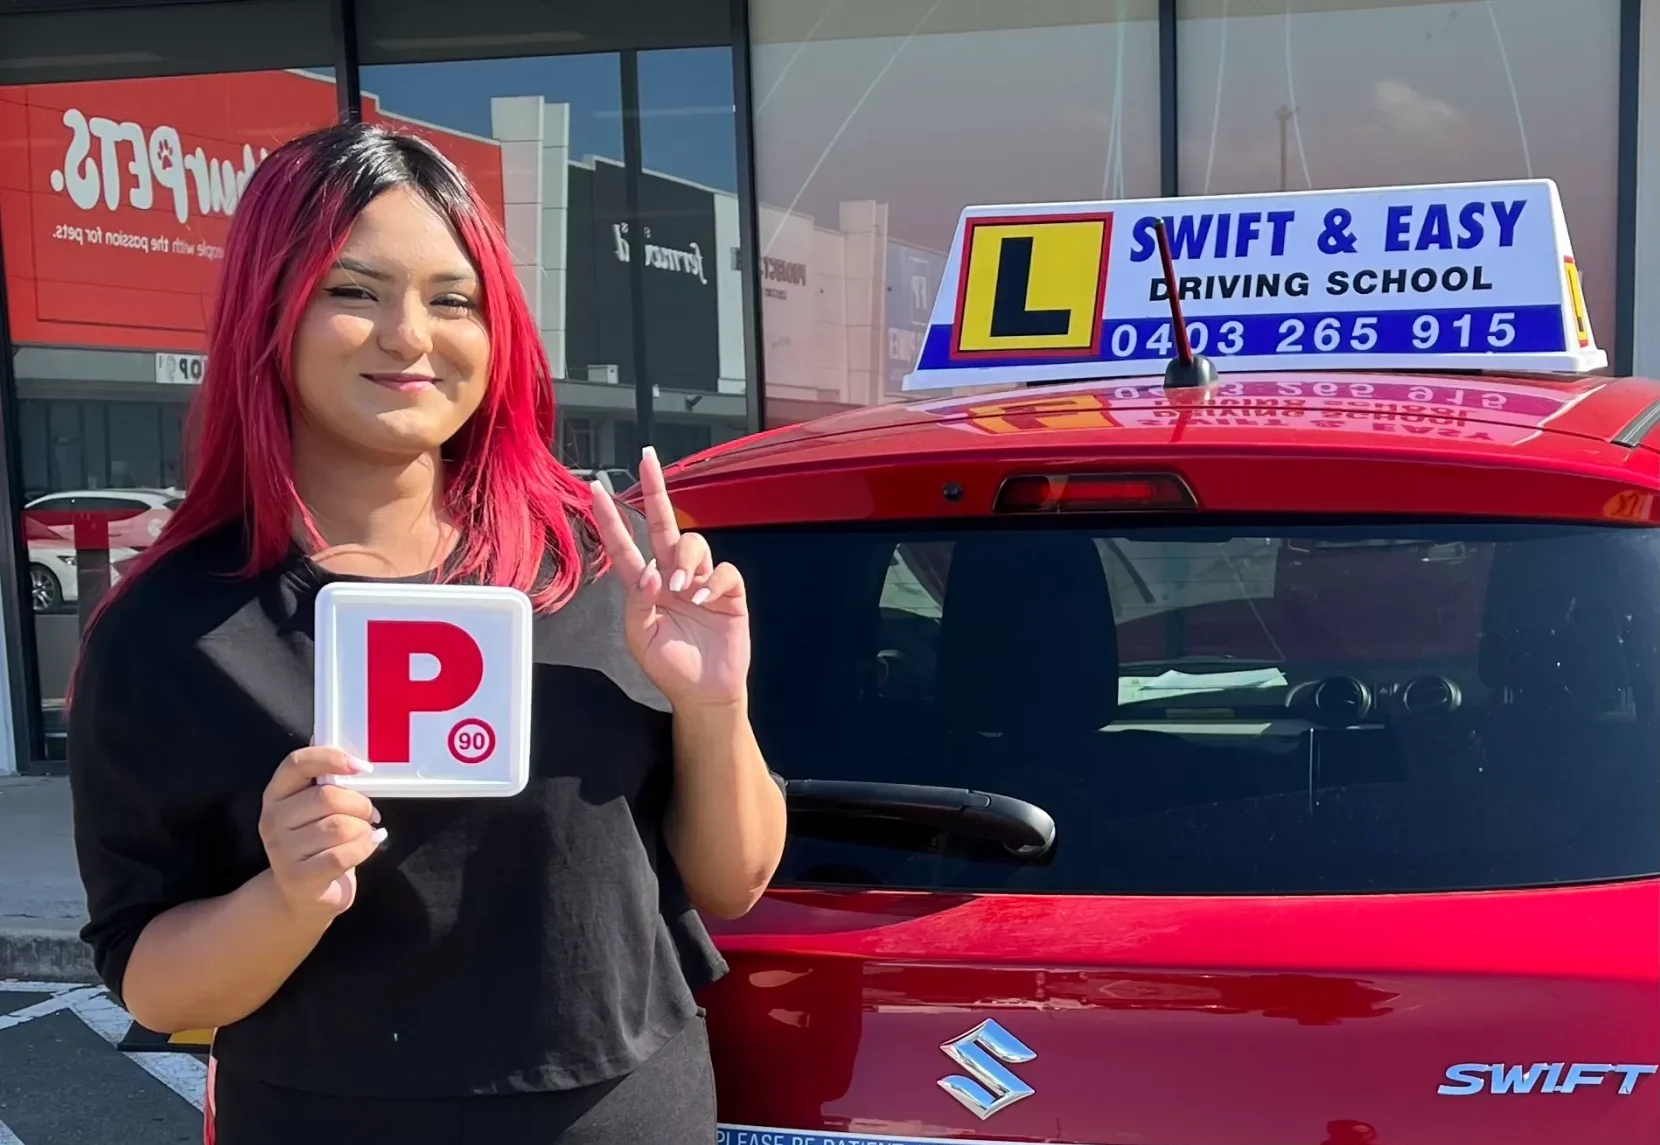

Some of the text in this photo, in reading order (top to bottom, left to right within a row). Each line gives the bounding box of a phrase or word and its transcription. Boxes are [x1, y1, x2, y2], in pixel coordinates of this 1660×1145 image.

[1130, 200, 1528, 263] SWIFT & EASY
[989, 236, 1072, 337] L
[1149, 265, 1493, 302] DRIVING SCHOOL
[1110, 312, 1516, 358] 0403 265 915
[367, 619, 484, 763] P
[458, 732, 485, 751] 90
[1437, 1062, 1659, 1096] SWIFT
